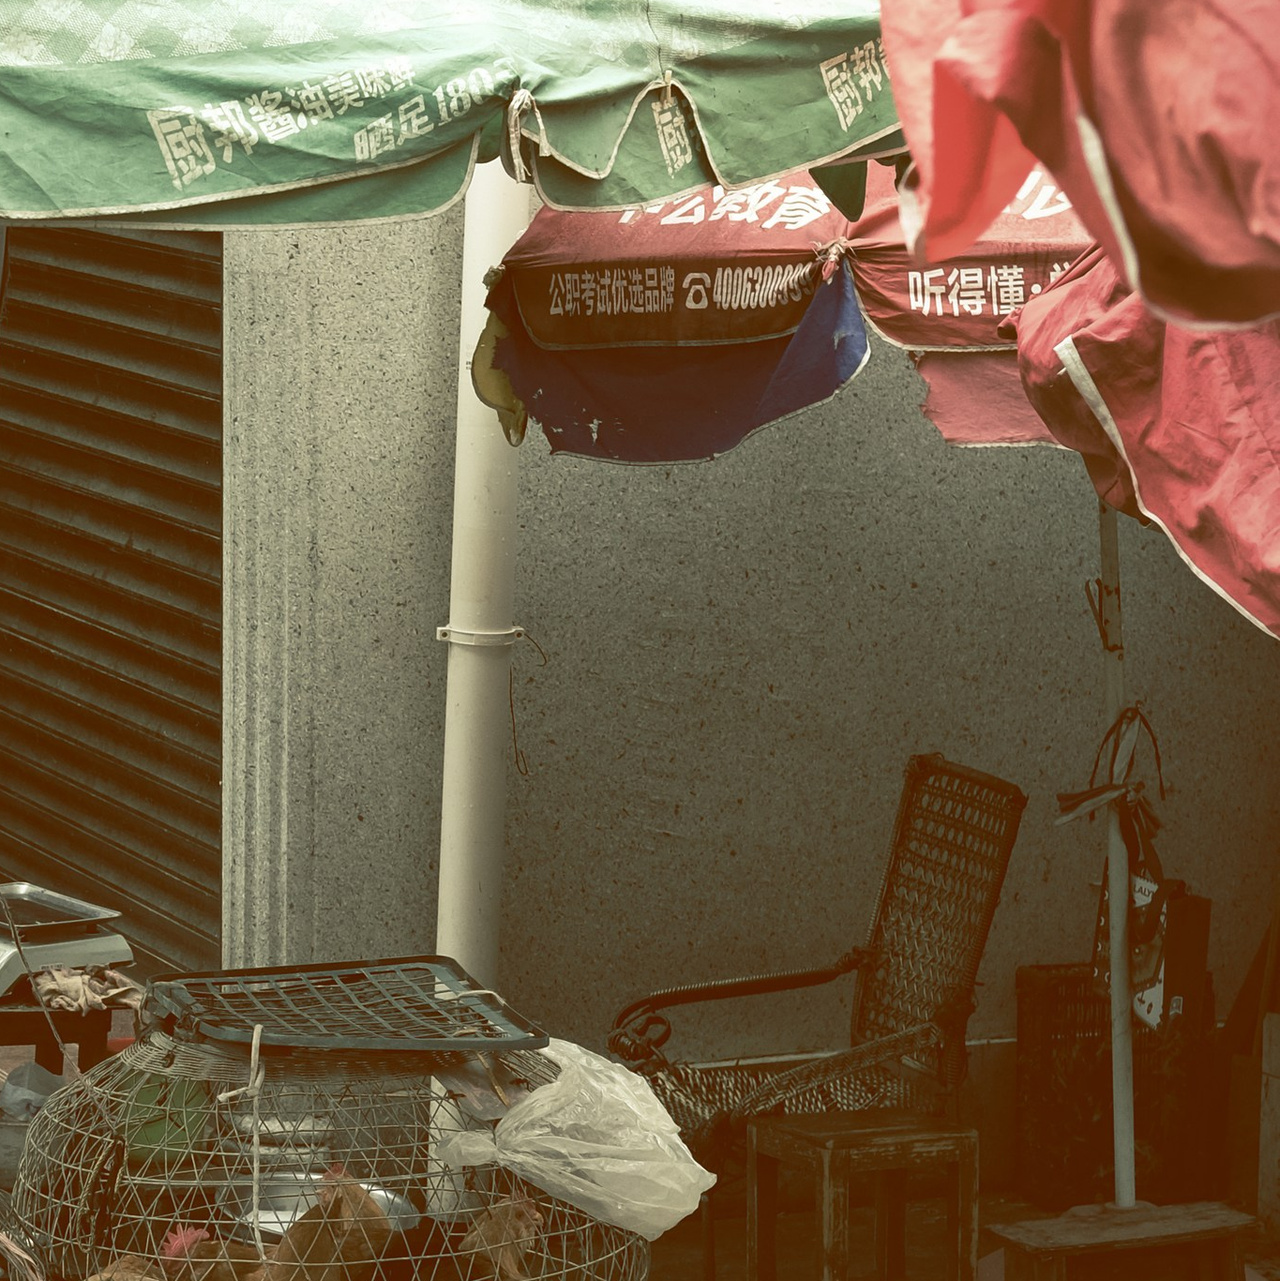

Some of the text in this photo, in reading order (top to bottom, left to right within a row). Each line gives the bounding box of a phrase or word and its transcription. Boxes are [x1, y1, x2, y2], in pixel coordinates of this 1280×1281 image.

[819, 37, 892, 133] 厨邦
[548, 265, 676, 317] 公职考试优选品牌
